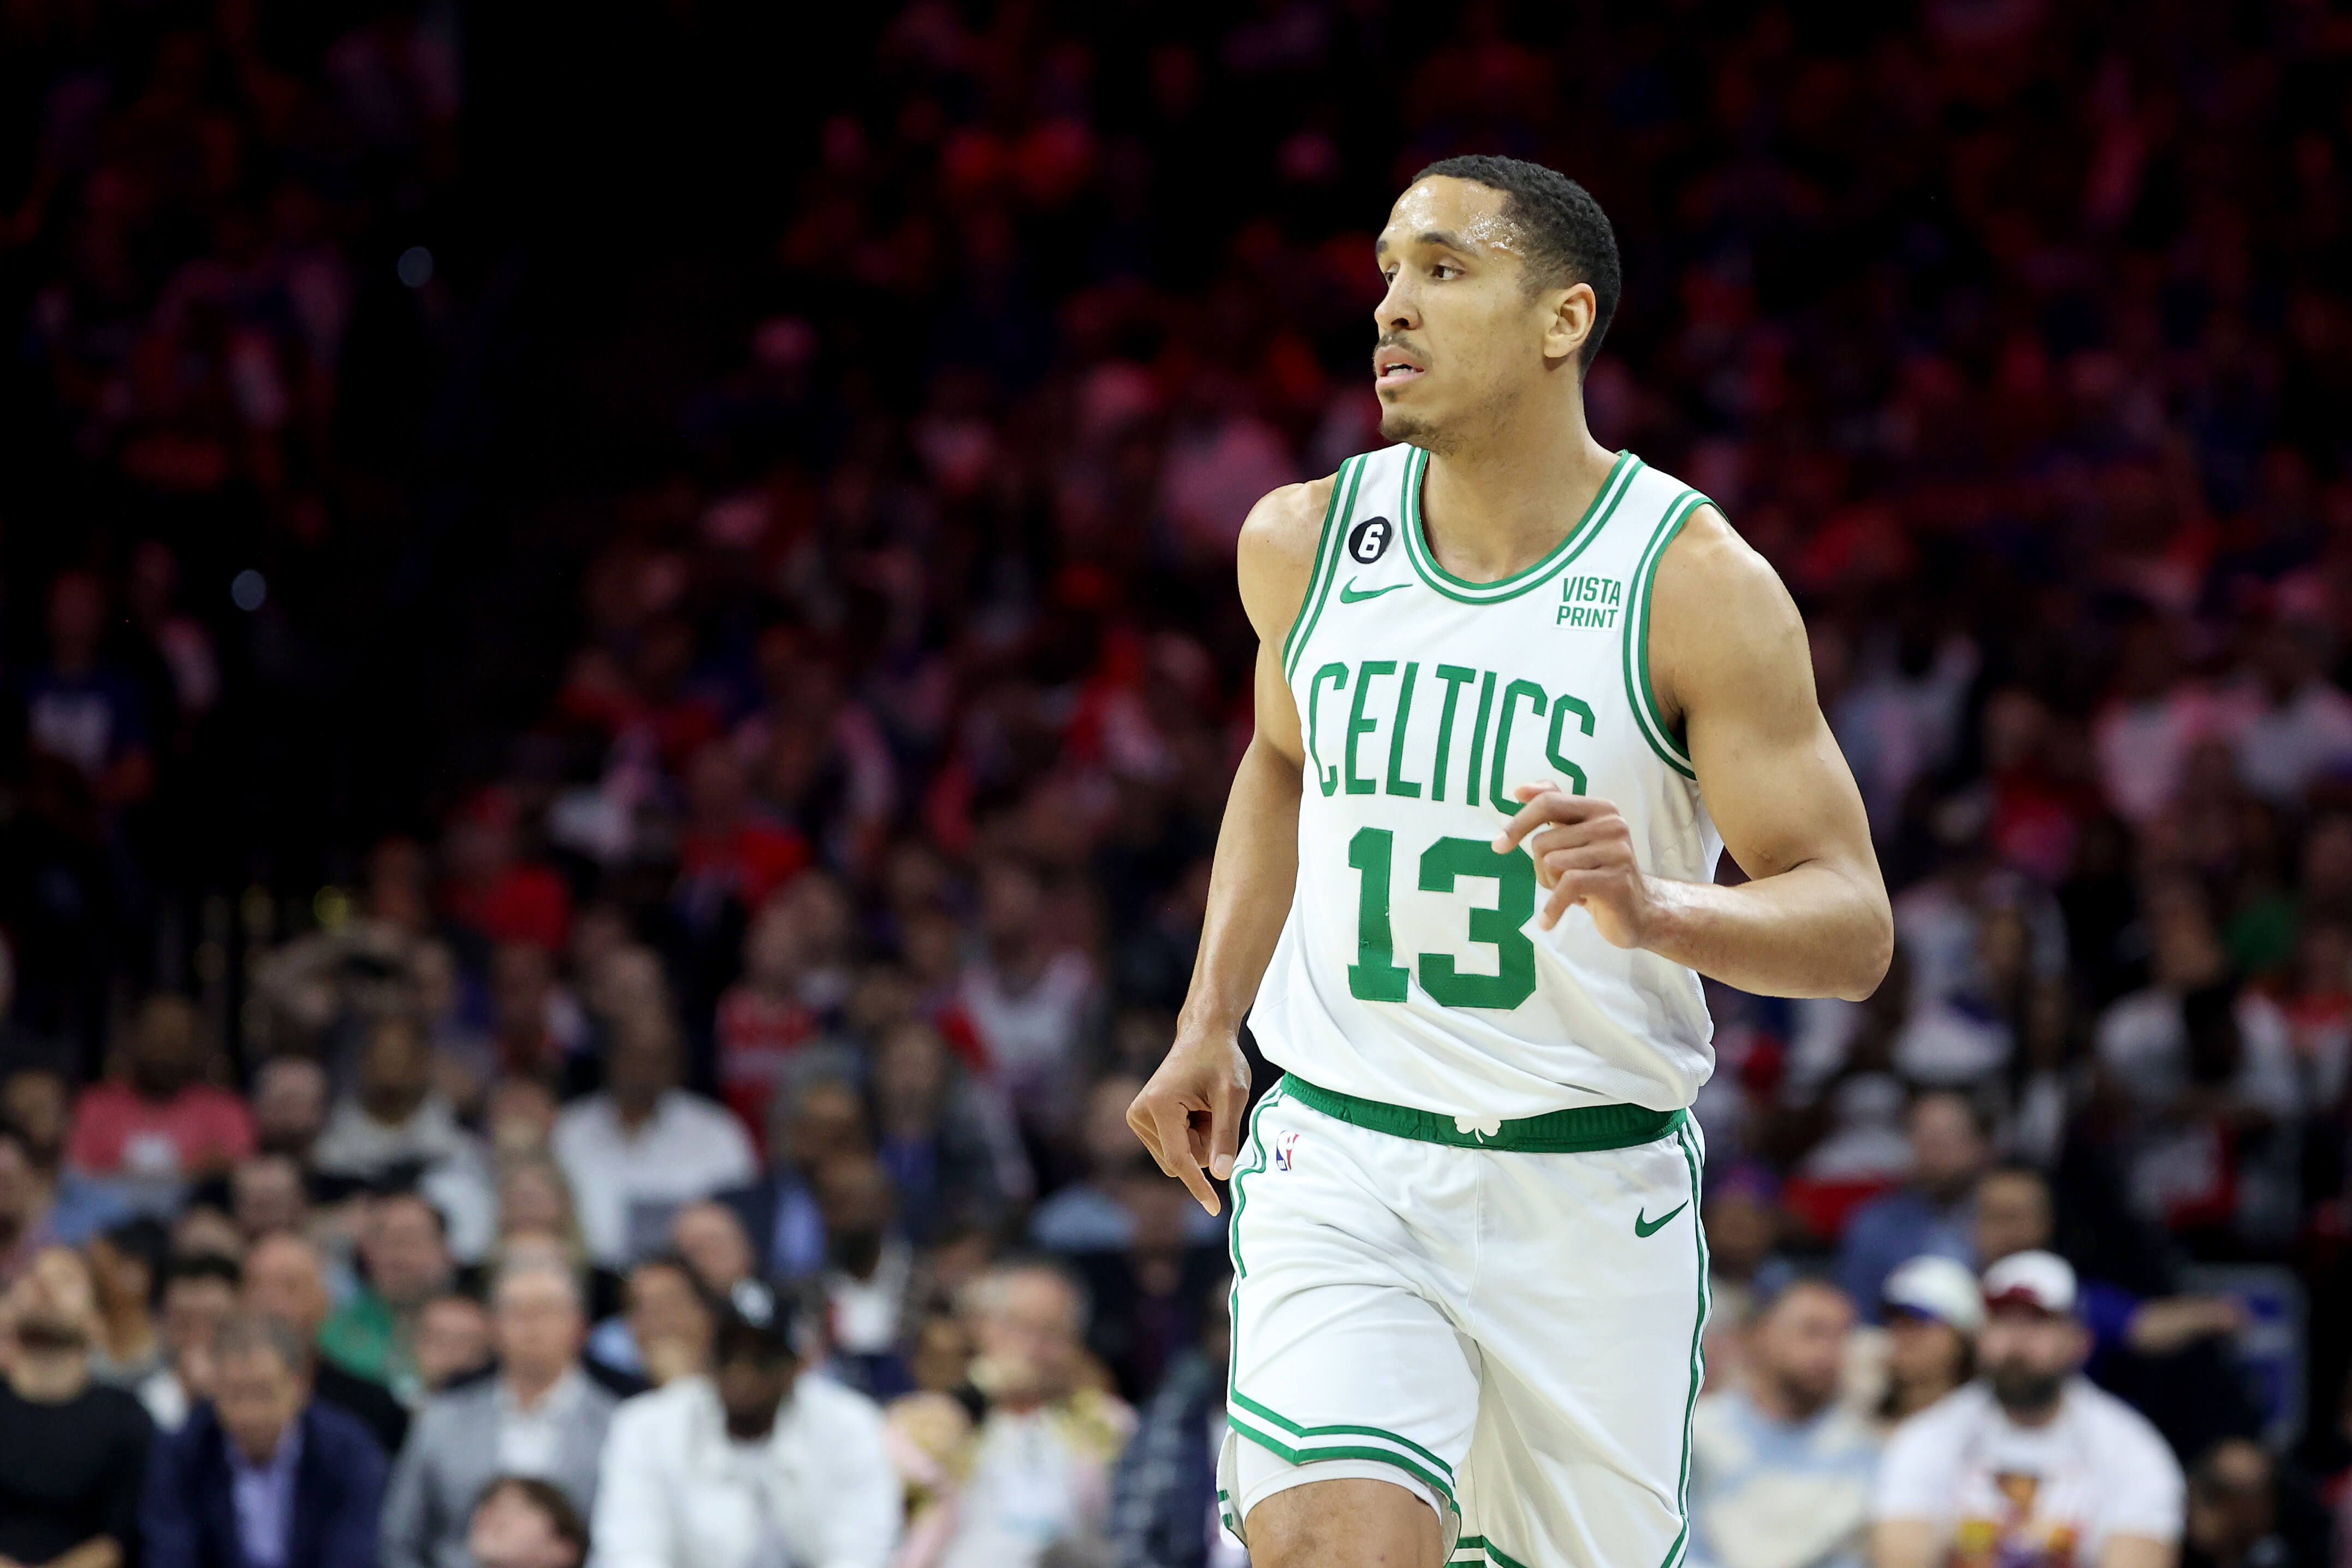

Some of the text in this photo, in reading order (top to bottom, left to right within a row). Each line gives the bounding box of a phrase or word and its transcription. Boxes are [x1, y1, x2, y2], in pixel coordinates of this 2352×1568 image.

[1358, 524, 1384, 559] 6
[1563, 576, 1621, 607] VISTA
[1556, 605, 1618, 628] PRINT
[1310, 661, 1595, 817] CELTICS
[1347, 826, 1536, 1010] 13
